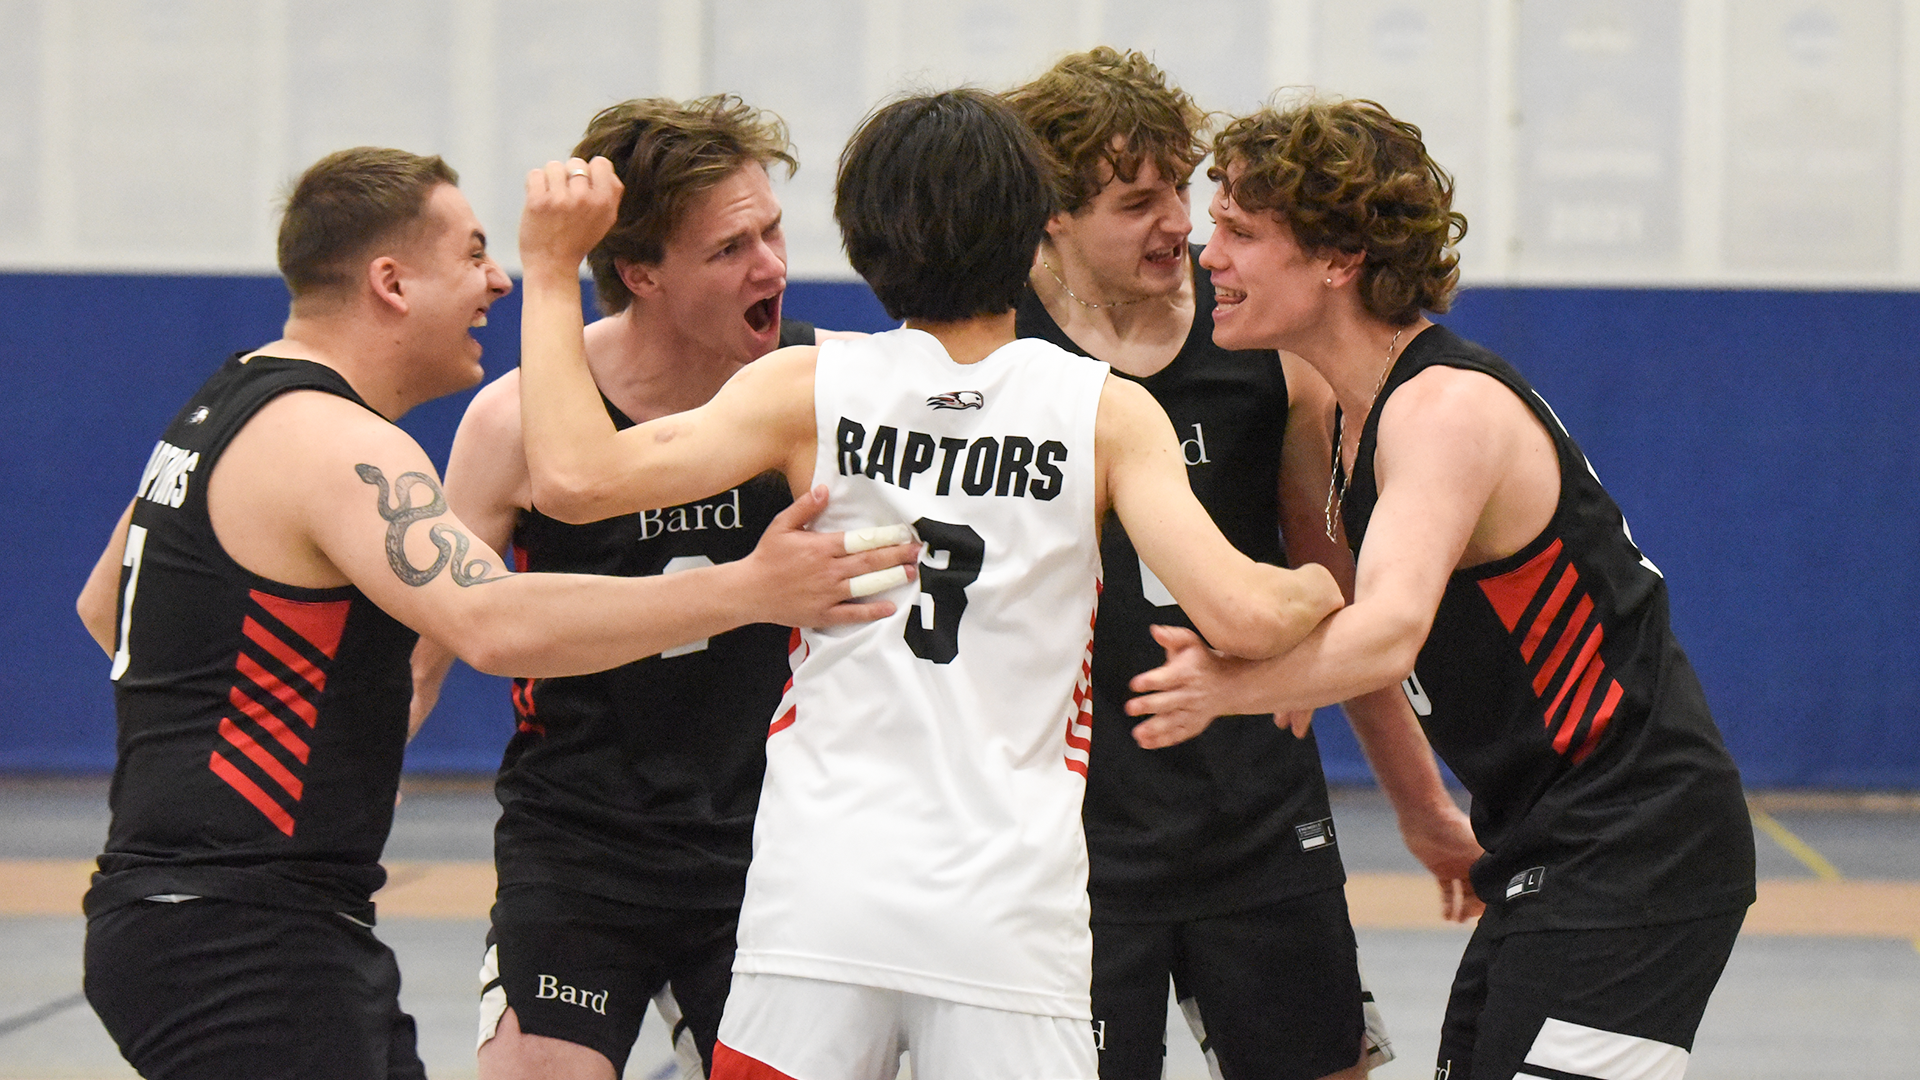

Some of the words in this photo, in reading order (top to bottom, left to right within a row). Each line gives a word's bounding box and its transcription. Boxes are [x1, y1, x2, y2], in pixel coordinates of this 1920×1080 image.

[836, 416, 1068, 502] RAPTORS
[638, 488, 744, 542] Bard
[903, 516, 986, 665] 3
[1527, 874, 1535, 886] L
[535, 974, 609, 1016] Bard
